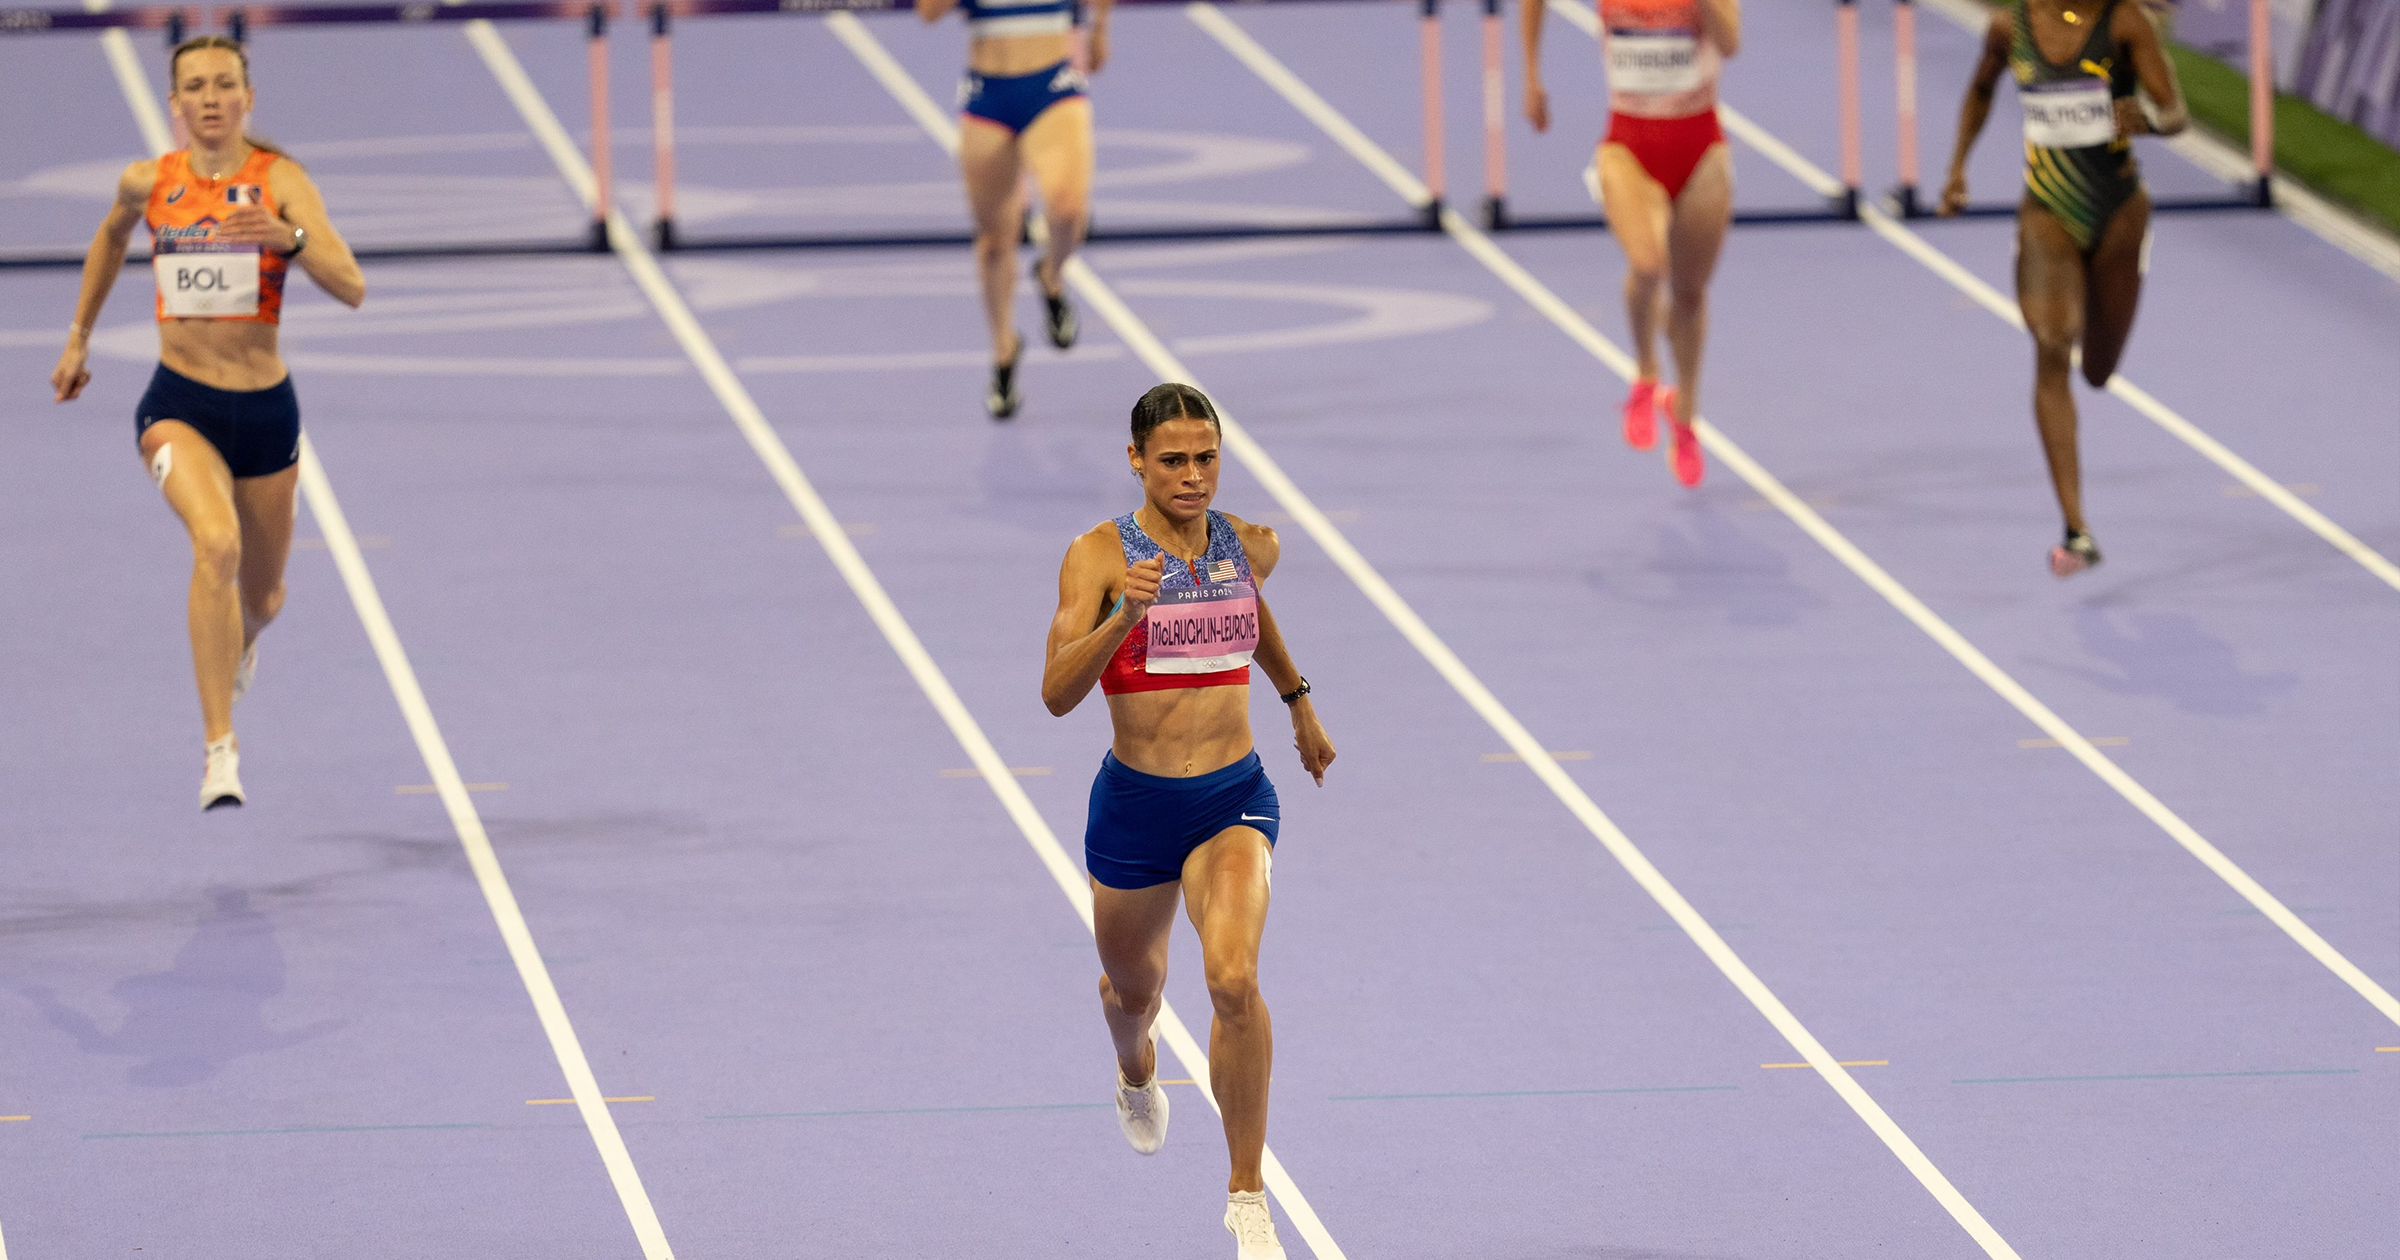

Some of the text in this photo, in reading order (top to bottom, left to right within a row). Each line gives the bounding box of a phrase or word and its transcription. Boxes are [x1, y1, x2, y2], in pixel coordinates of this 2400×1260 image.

[177, 267, 230, 291] BOL
[1178, 588, 1233, 600] PARIS 2024
[1151, 612, 1255, 646] McLAUGHLIN-LEVRONE
